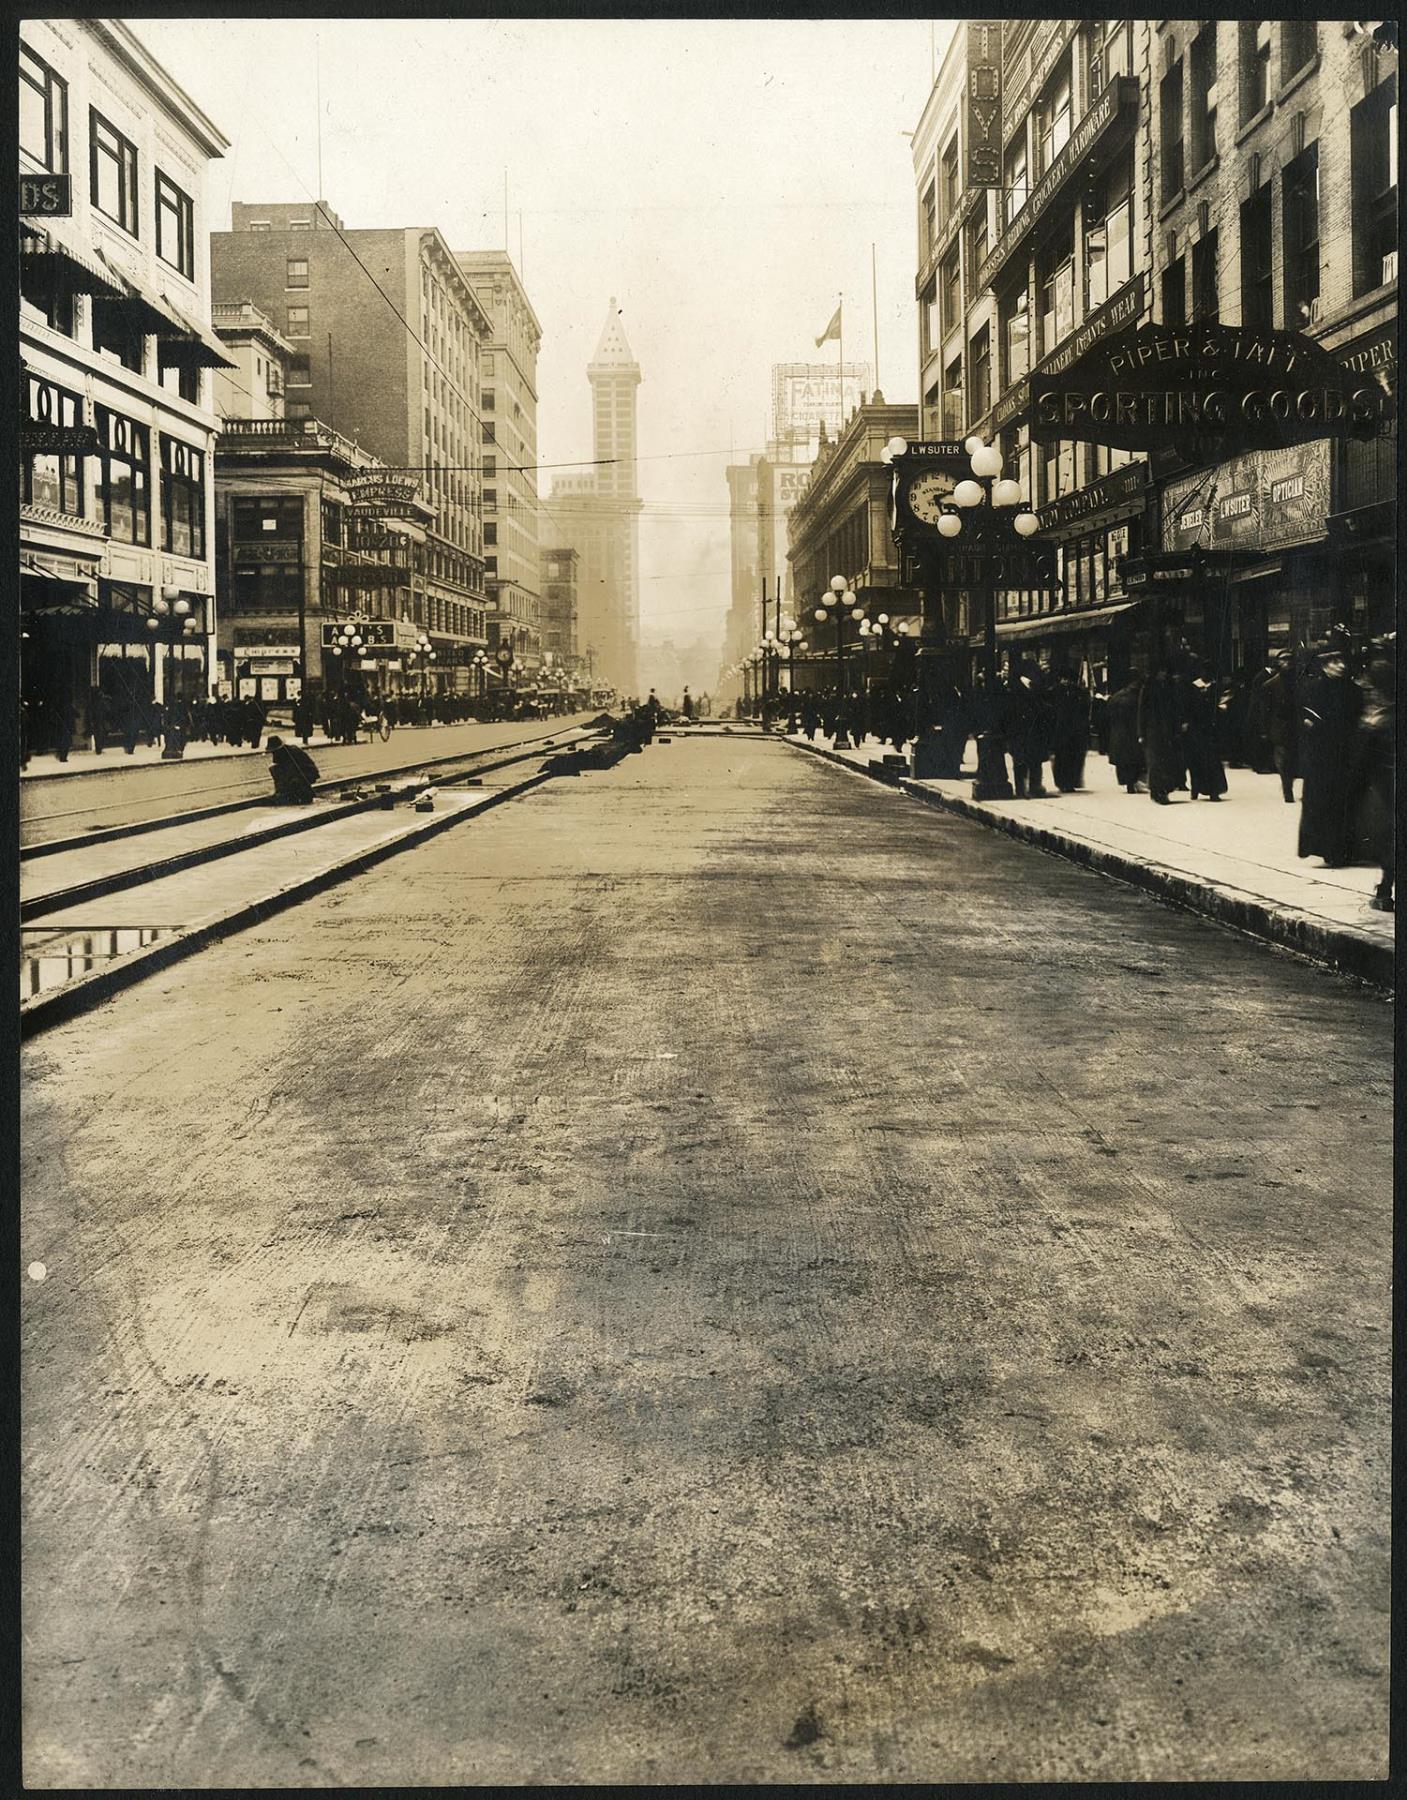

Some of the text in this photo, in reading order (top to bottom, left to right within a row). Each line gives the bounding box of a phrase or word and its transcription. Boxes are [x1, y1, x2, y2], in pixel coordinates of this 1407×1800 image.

[970, 25, 999, 182] TOYS
[1069, 94, 1112, 164] HARDWARE
[1110, 291, 1136, 326] WEAR
[1109, 338, 1191, 377] PIPER
[1202, 338, 1221, 357] &
[1038, 391, 1225, 425] SPORTING
[1241, 389, 1375, 423] GOODS
[346, 507, 415, 516] VAUDEVILLE
[351, 486, 412, 501] EMPRESS
